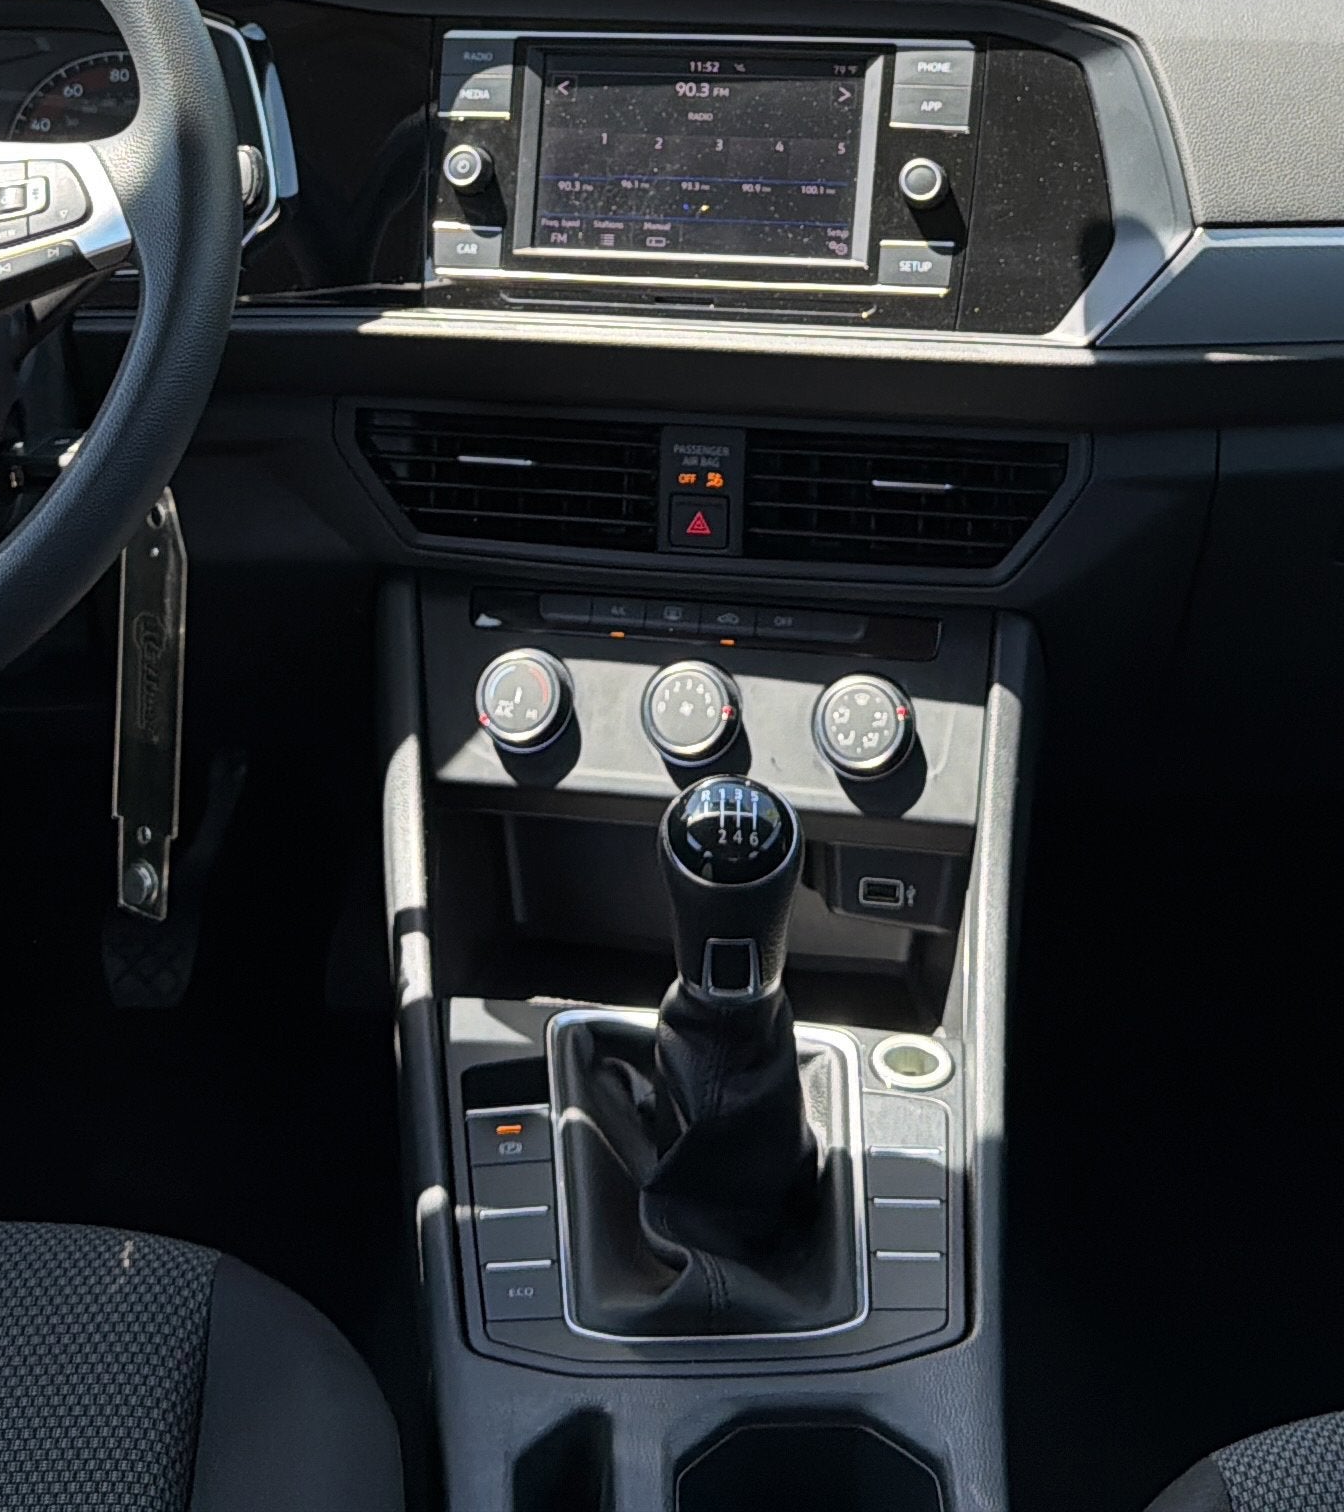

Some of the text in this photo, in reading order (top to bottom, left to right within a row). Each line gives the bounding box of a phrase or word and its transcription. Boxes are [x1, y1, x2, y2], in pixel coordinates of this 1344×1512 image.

[463, 51, 493, 62] RADIO
[689, 61, 720, 73] 11:52
[917, 61, 951, 74] PHONE
[110, 68, 130, 83] 80
[63, 84, 83, 97] 60
[459, 89, 490, 100] MEDIA
[675, 82, 730, 97] 90.3 FM
[920, 100, 942, 113] APP
[688, 112, 714, 121] RADIO
[31, 118, 50, 132] 40
[601, 133, 608, 145] 1
[655, 137, 663, 149] 2
[715, 139, 723, 151] 3
[775, 141, 784, 152] 4
[837, 143, 846, 155] 5
[550, 232, 568, 243] FM
[456, 242, 478, 255] CAR
[899, 260, 932, 274] SETUP
[673, 443, 730, 456] PASSENGER
[678, 473, 697, 484] OFF
[773, 615, 793, 627] OFF
[701, 788, 759, 802] R 1 3 5
[718, 828, 759, 847] 2 4 6
[508, 1287, 534, 1297] ECO
